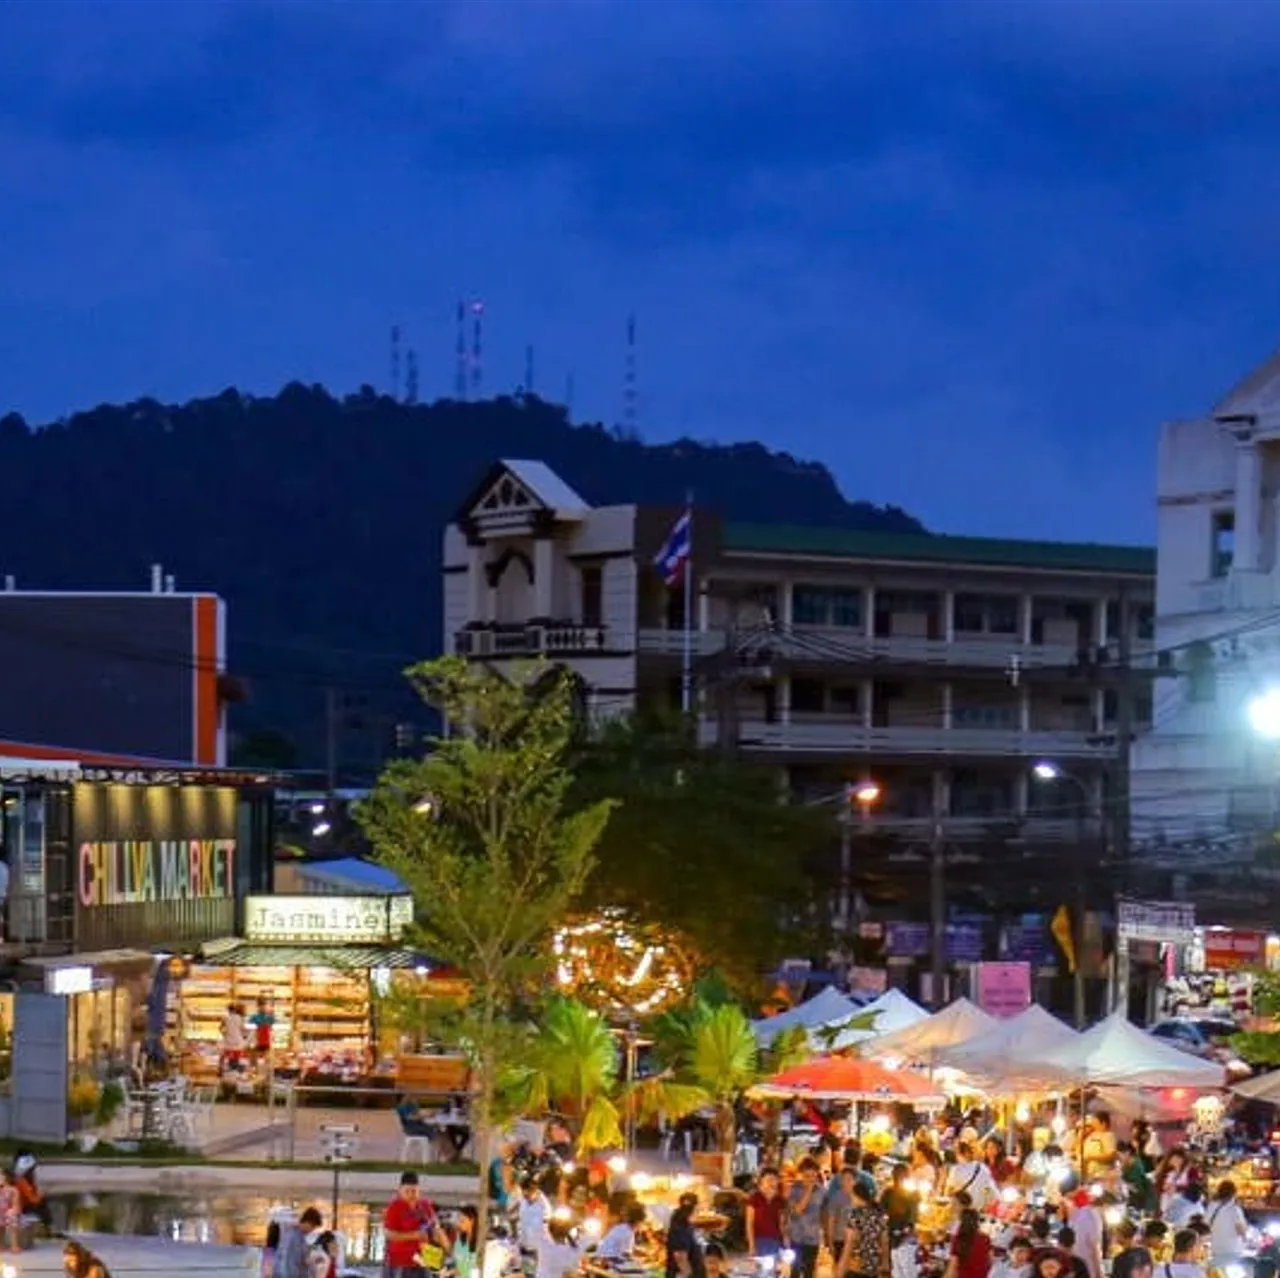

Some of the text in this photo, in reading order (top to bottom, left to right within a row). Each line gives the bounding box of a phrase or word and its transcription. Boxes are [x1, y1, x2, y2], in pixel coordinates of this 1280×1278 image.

[78, 838, 237, 907] CHILLVA MARKET
[252, 906, 380, 930] Jasmine
